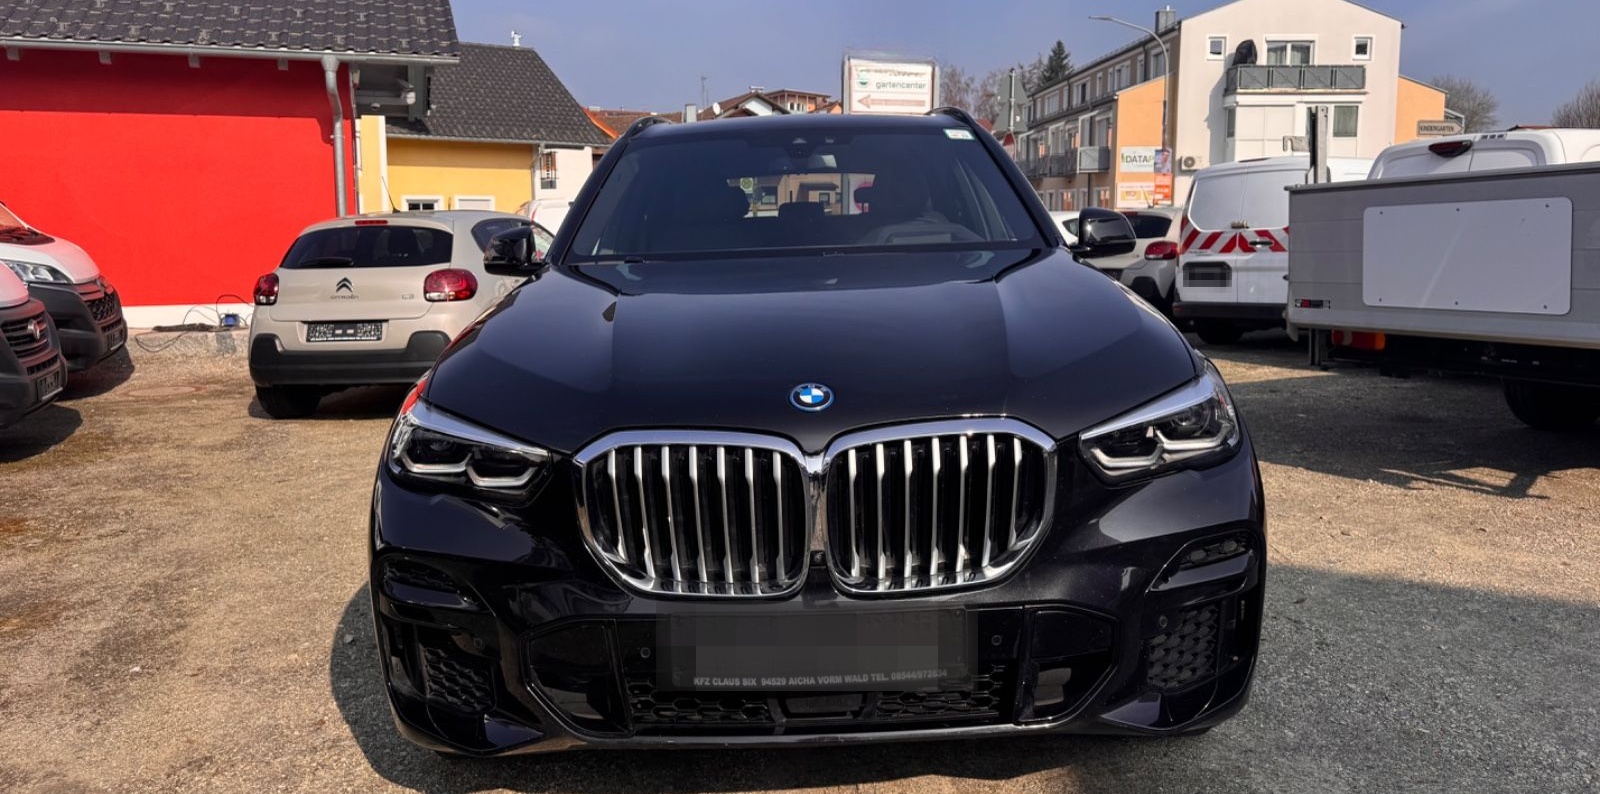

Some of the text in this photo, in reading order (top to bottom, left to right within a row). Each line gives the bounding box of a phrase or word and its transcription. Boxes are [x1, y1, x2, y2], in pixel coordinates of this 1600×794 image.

[875, 81, 926, 89] gartencenter
[693, 677, 711, 686] KFZ
[712, 677, 741, 686] CLAUS
[742, 677, 757, 686] SIX
[761, 677, 787, 686] 94529
[788, 676, 816, 685] AICHA
[817, 675, 843, 684] VORM
[844, 674, 869, 683] WALD
[870, 673, 889, 681] TEL.
